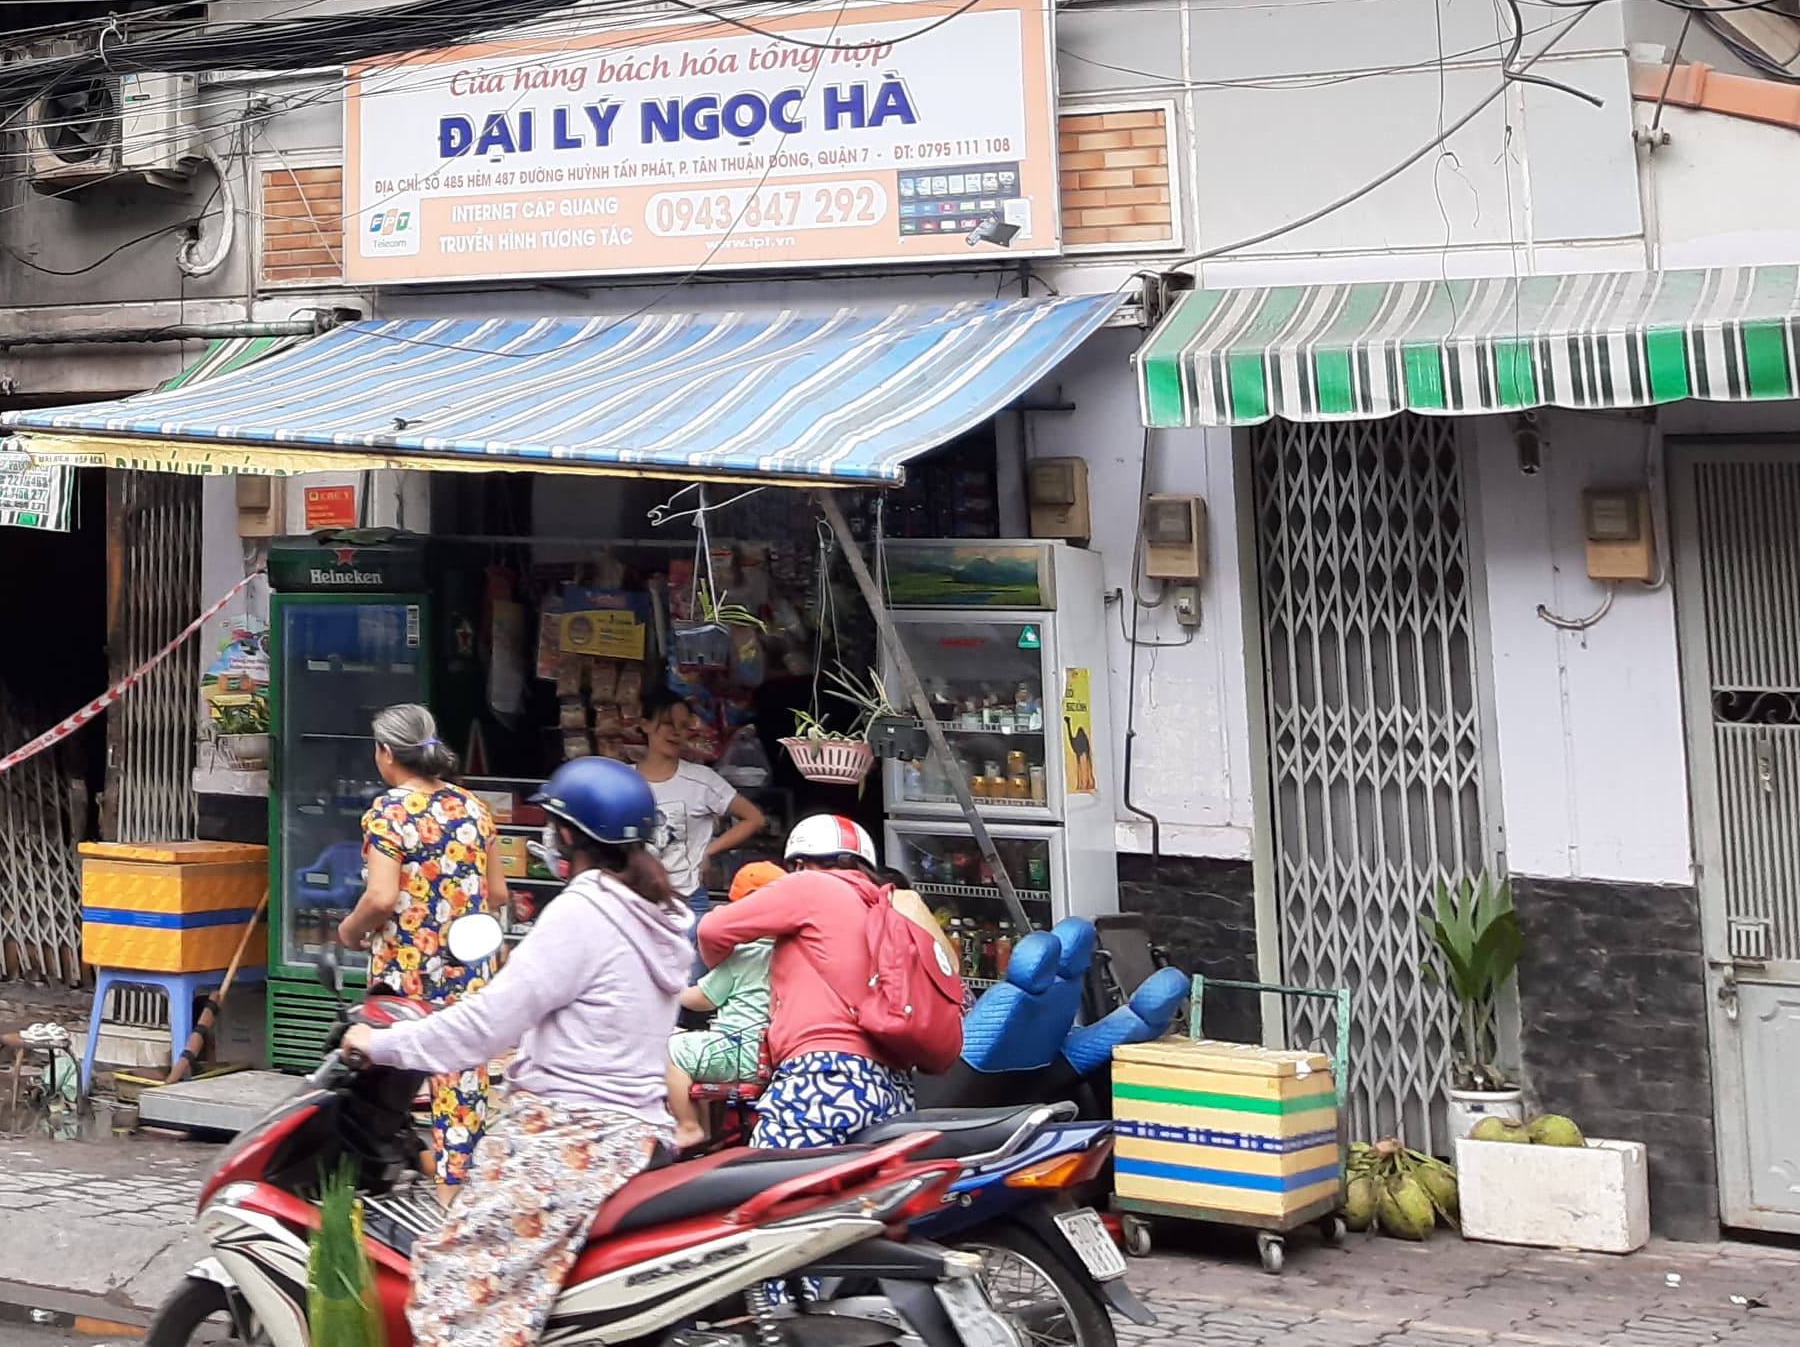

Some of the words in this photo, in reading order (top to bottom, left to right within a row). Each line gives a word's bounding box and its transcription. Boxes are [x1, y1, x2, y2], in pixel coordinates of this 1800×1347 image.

[449, 67, 504, 96] Cửa
[513, 63, 588, 92] hàng
[597, 55, 670, 84] bách
[679, 50, 739, 78] hóa
[437, 110, 535, 163] ĐẠI
[553, 97, 625, 150] LÝ
[640, 89, 805, 146] NGỌC
[822, 71, 919, 131] HÀ
[444, 175, 464, 189] 485
[495, 172, 515, 185] 487
[861, 148, 869, 162] 7
[918, 142, 950, 158] 0795
[955, 139, 978, 156] 111
[986, 137, 1010, 154] 108
[369, 208, 411, 236] FPT
[452, 202, 517, 223] INTERNET
[559, 196, 618, 217] QUANG
[657, 195, 733, 233] 0943
[745, 190, 801, 228] 847
[815, 186, 876, 224] 292
[600, 223, 633, 246] TÁC
[310, 568, 383, 584] Heineken
